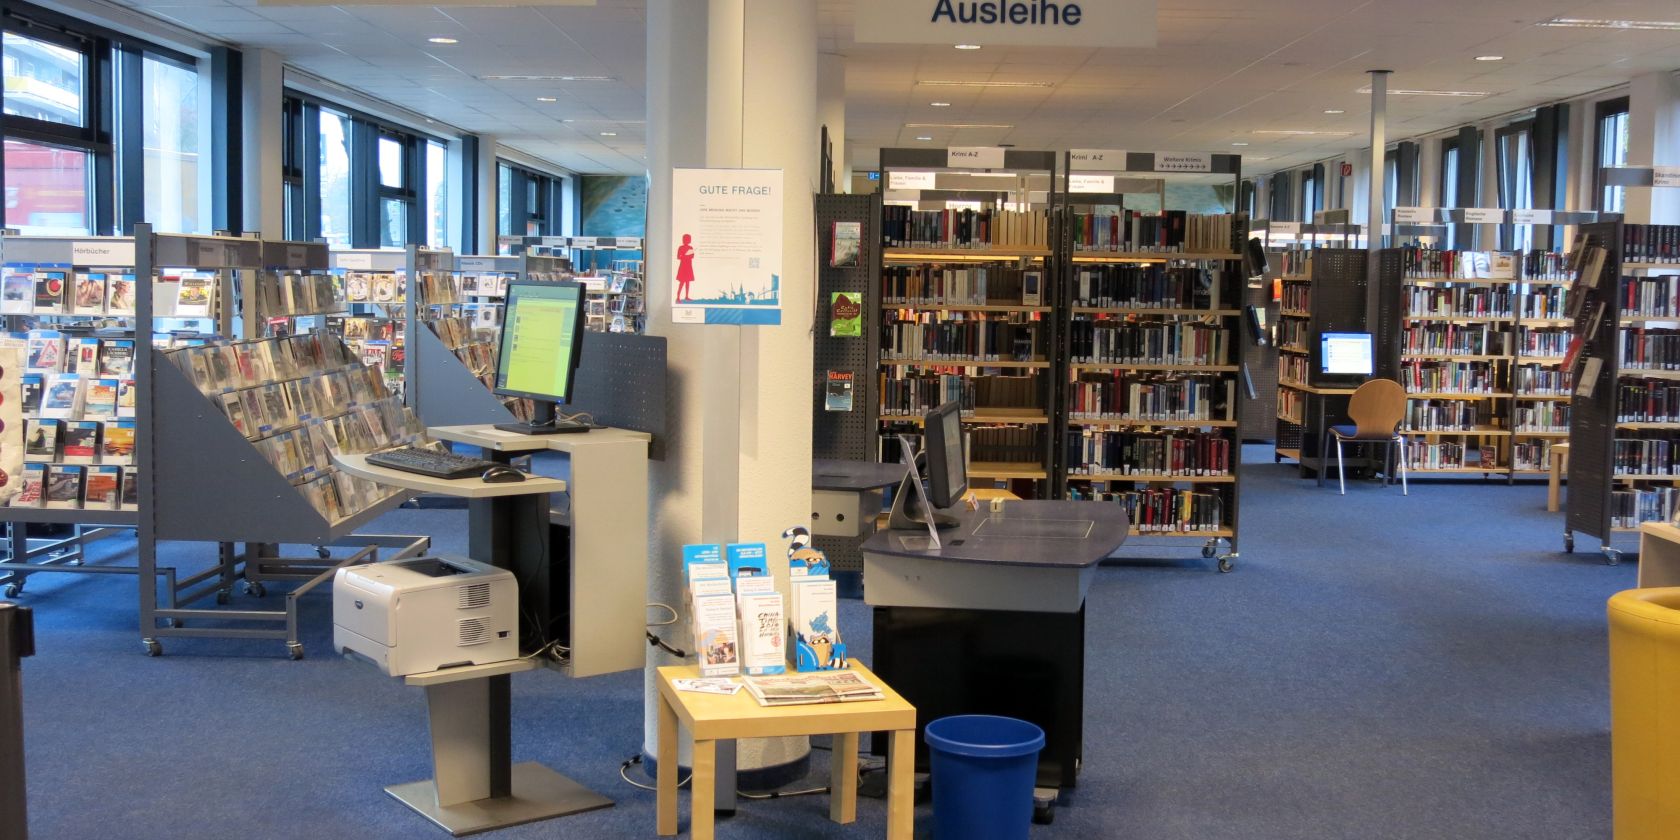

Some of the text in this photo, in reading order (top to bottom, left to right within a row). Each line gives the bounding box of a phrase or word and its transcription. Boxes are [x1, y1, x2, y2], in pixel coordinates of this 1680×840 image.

[931, 0, 1082, 25] Ausleihe
[699, 185, 772, 196] GUTE FRAGE!
[74, 247, 111, 255] Hörbücher
[829, 371, 852, 380] HARVEY
